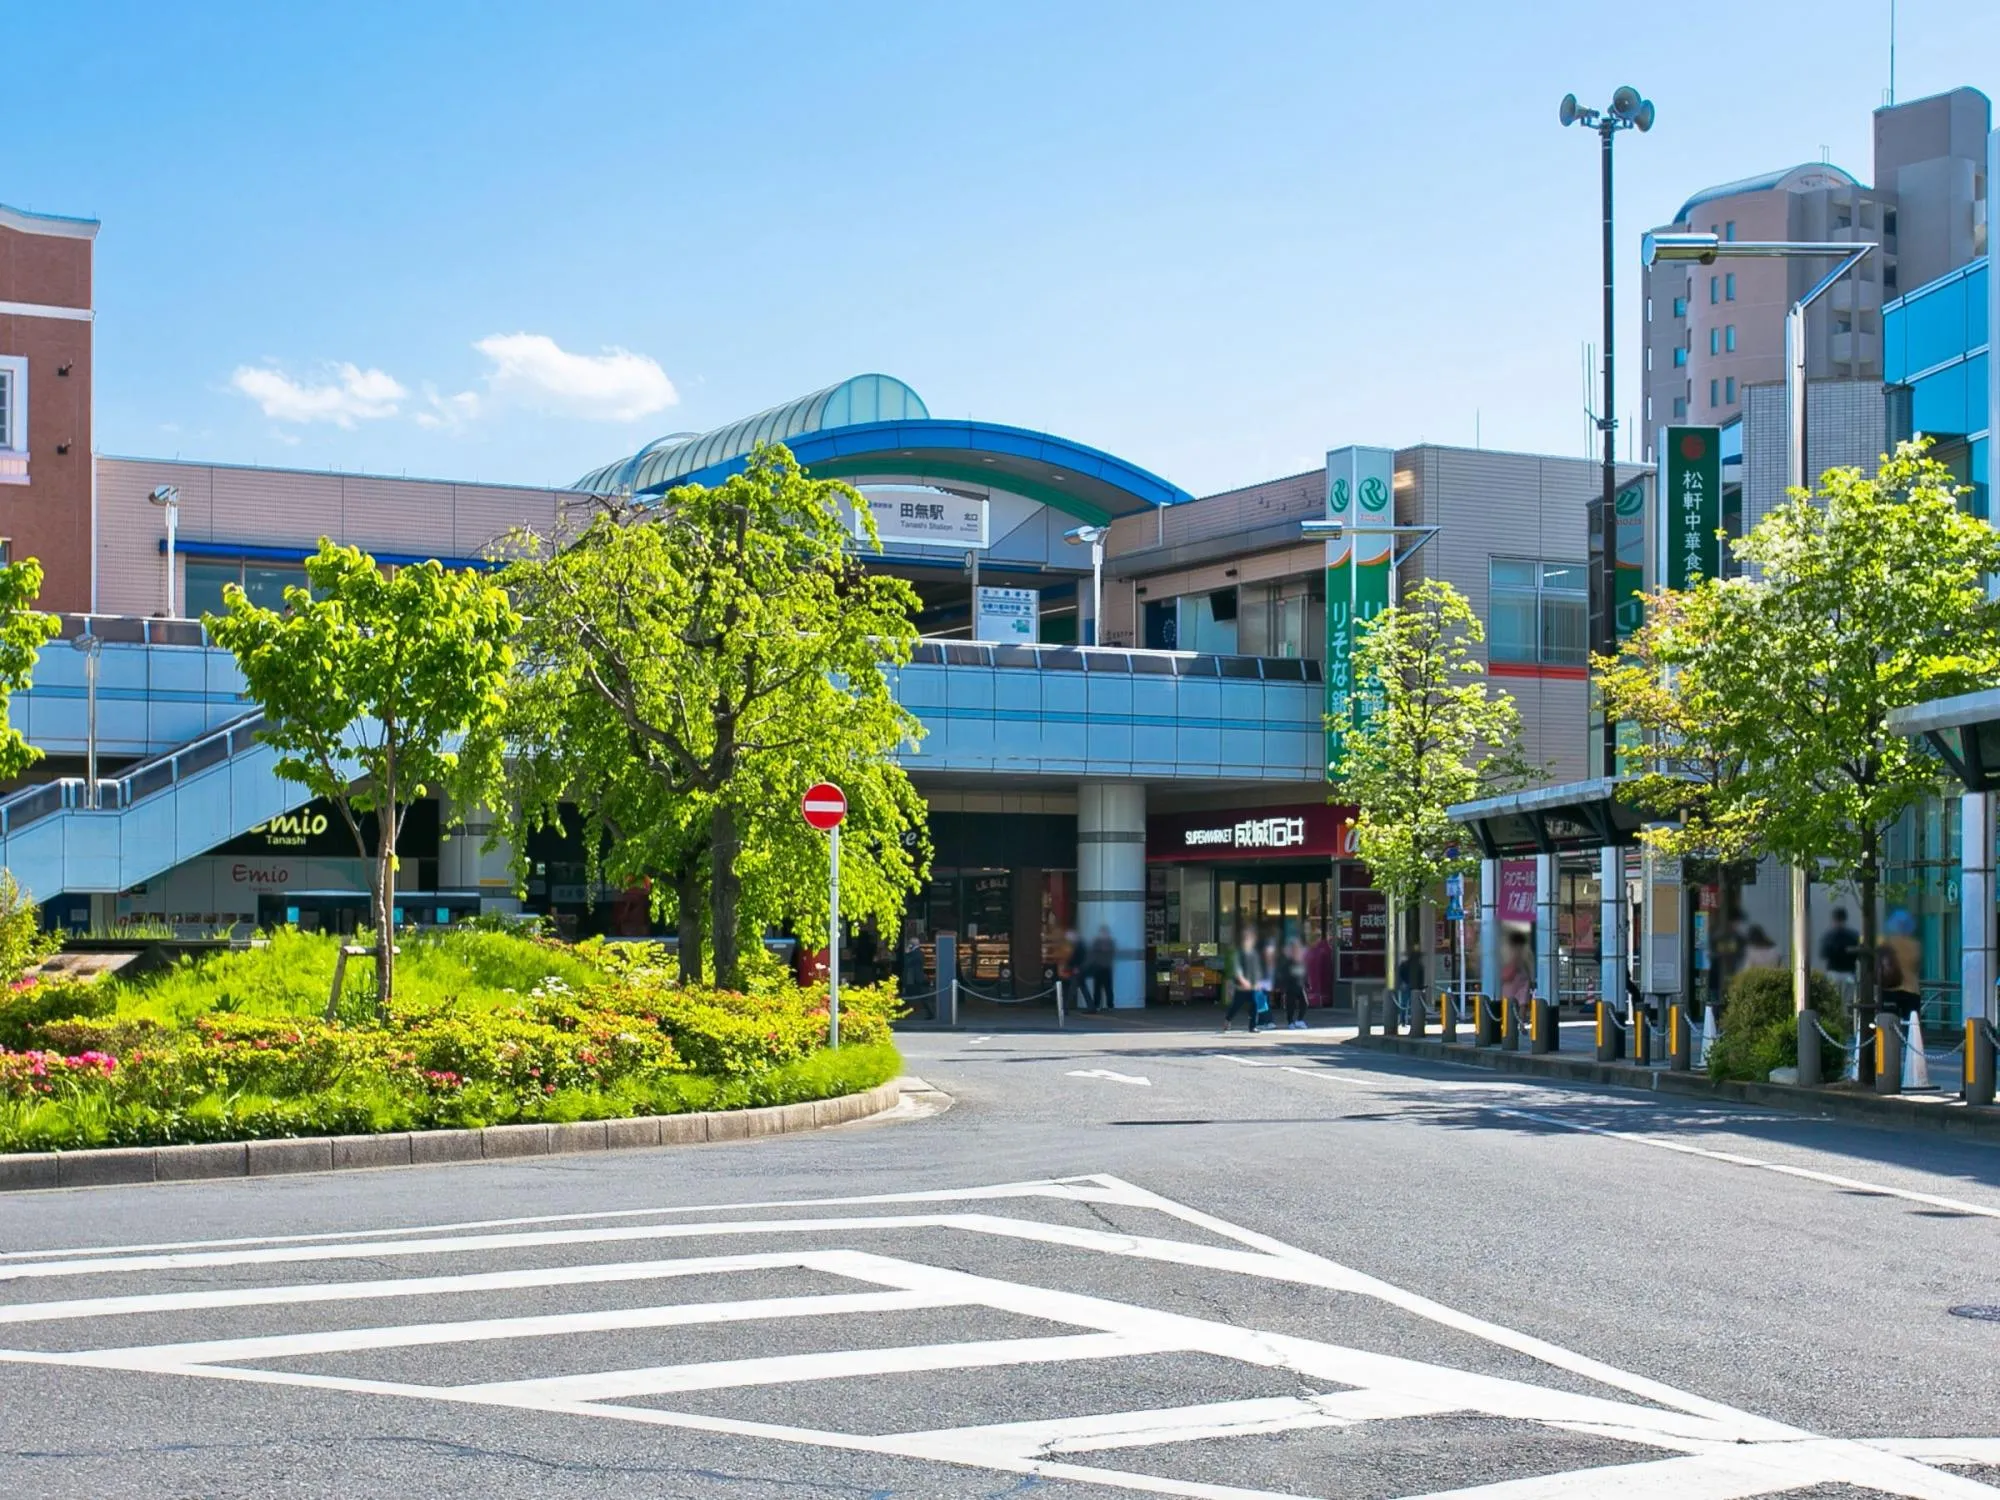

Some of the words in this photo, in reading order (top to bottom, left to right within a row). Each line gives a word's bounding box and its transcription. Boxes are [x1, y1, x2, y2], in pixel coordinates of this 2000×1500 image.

[900, 503, 945, 520] 田無駅
[963, 513, 978, 521] 北口
[1331, 601, 1349, 748] りそな銀
[249, 807, 328, 835] mio
[265, 835, 307, 845] Tanashi
[1185, 829, 1233, 845] SUPERMARKET
[1235, 817, 1304, 848] 成城石井
[231, 864, 289, 884] Emio
